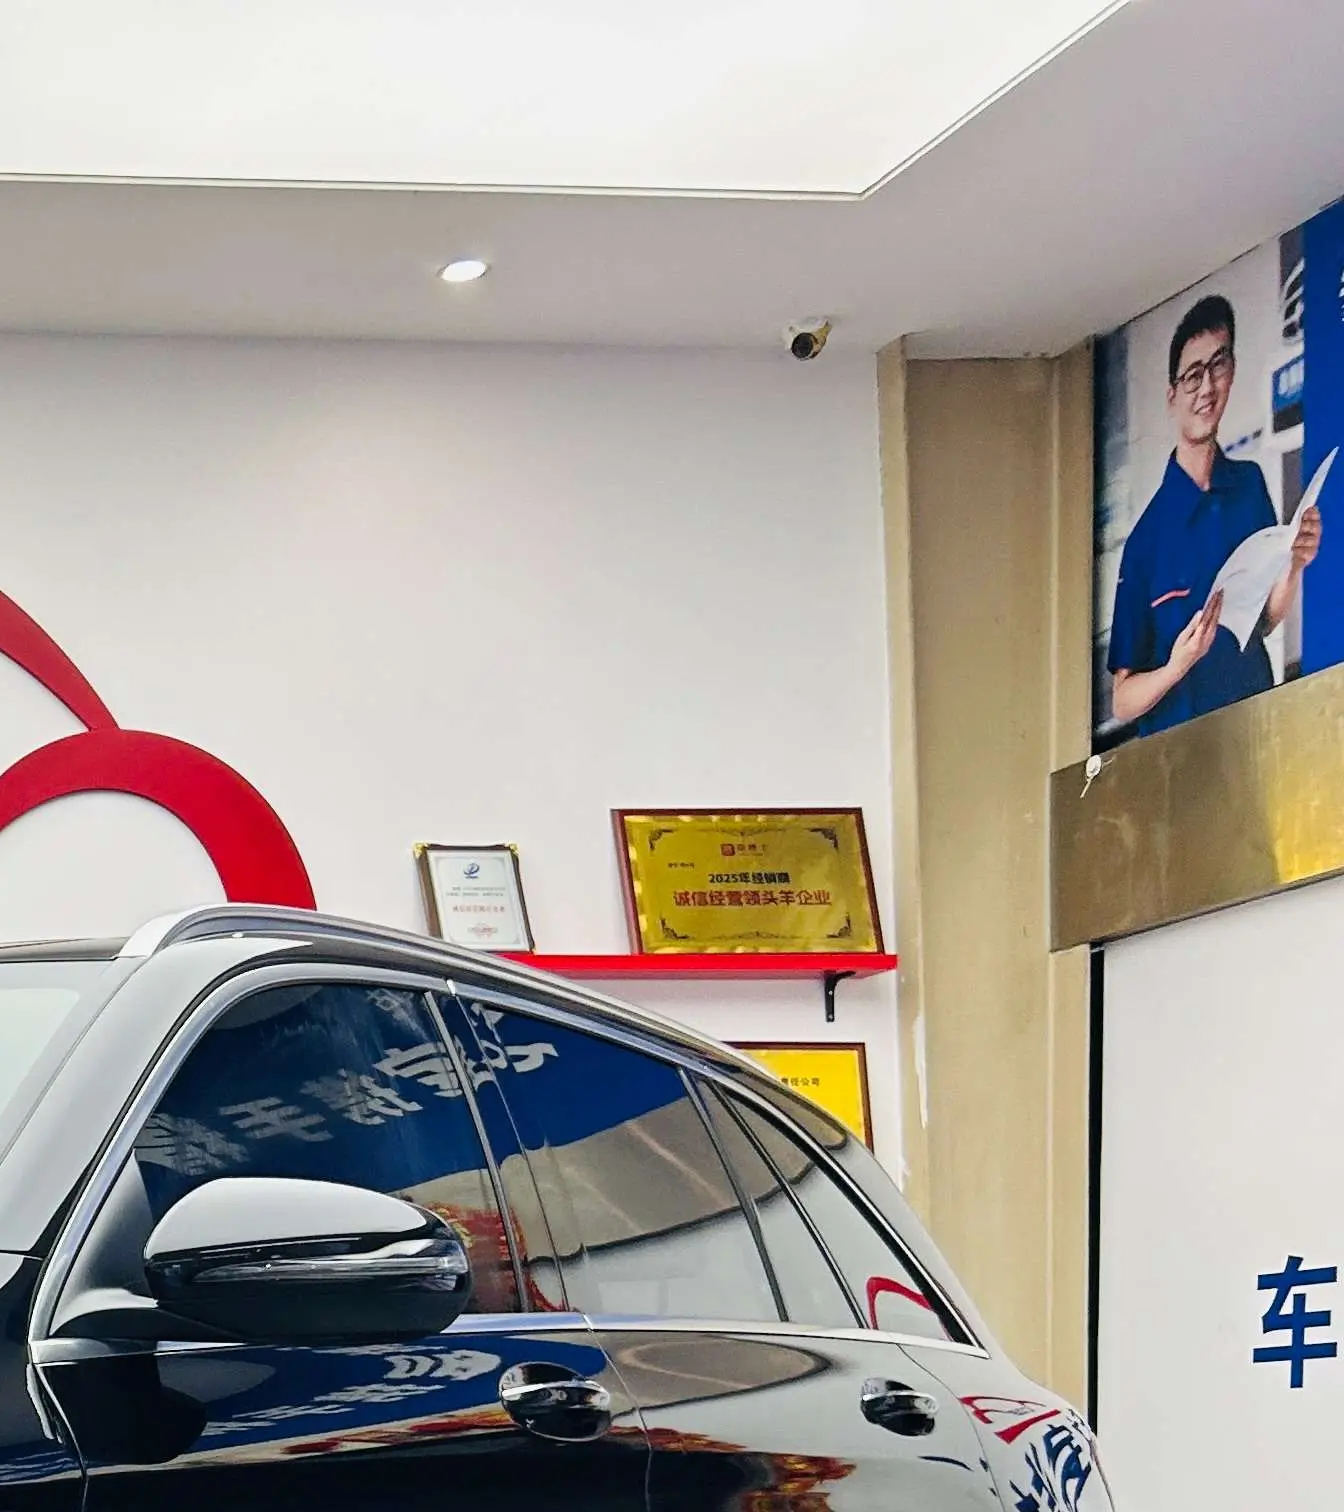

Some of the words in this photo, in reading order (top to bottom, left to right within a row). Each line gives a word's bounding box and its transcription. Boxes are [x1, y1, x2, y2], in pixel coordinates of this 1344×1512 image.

[673, 889, 832, 907] 诚信经营领头羊企业
[1252, 1255, 1338, 1389] 车
